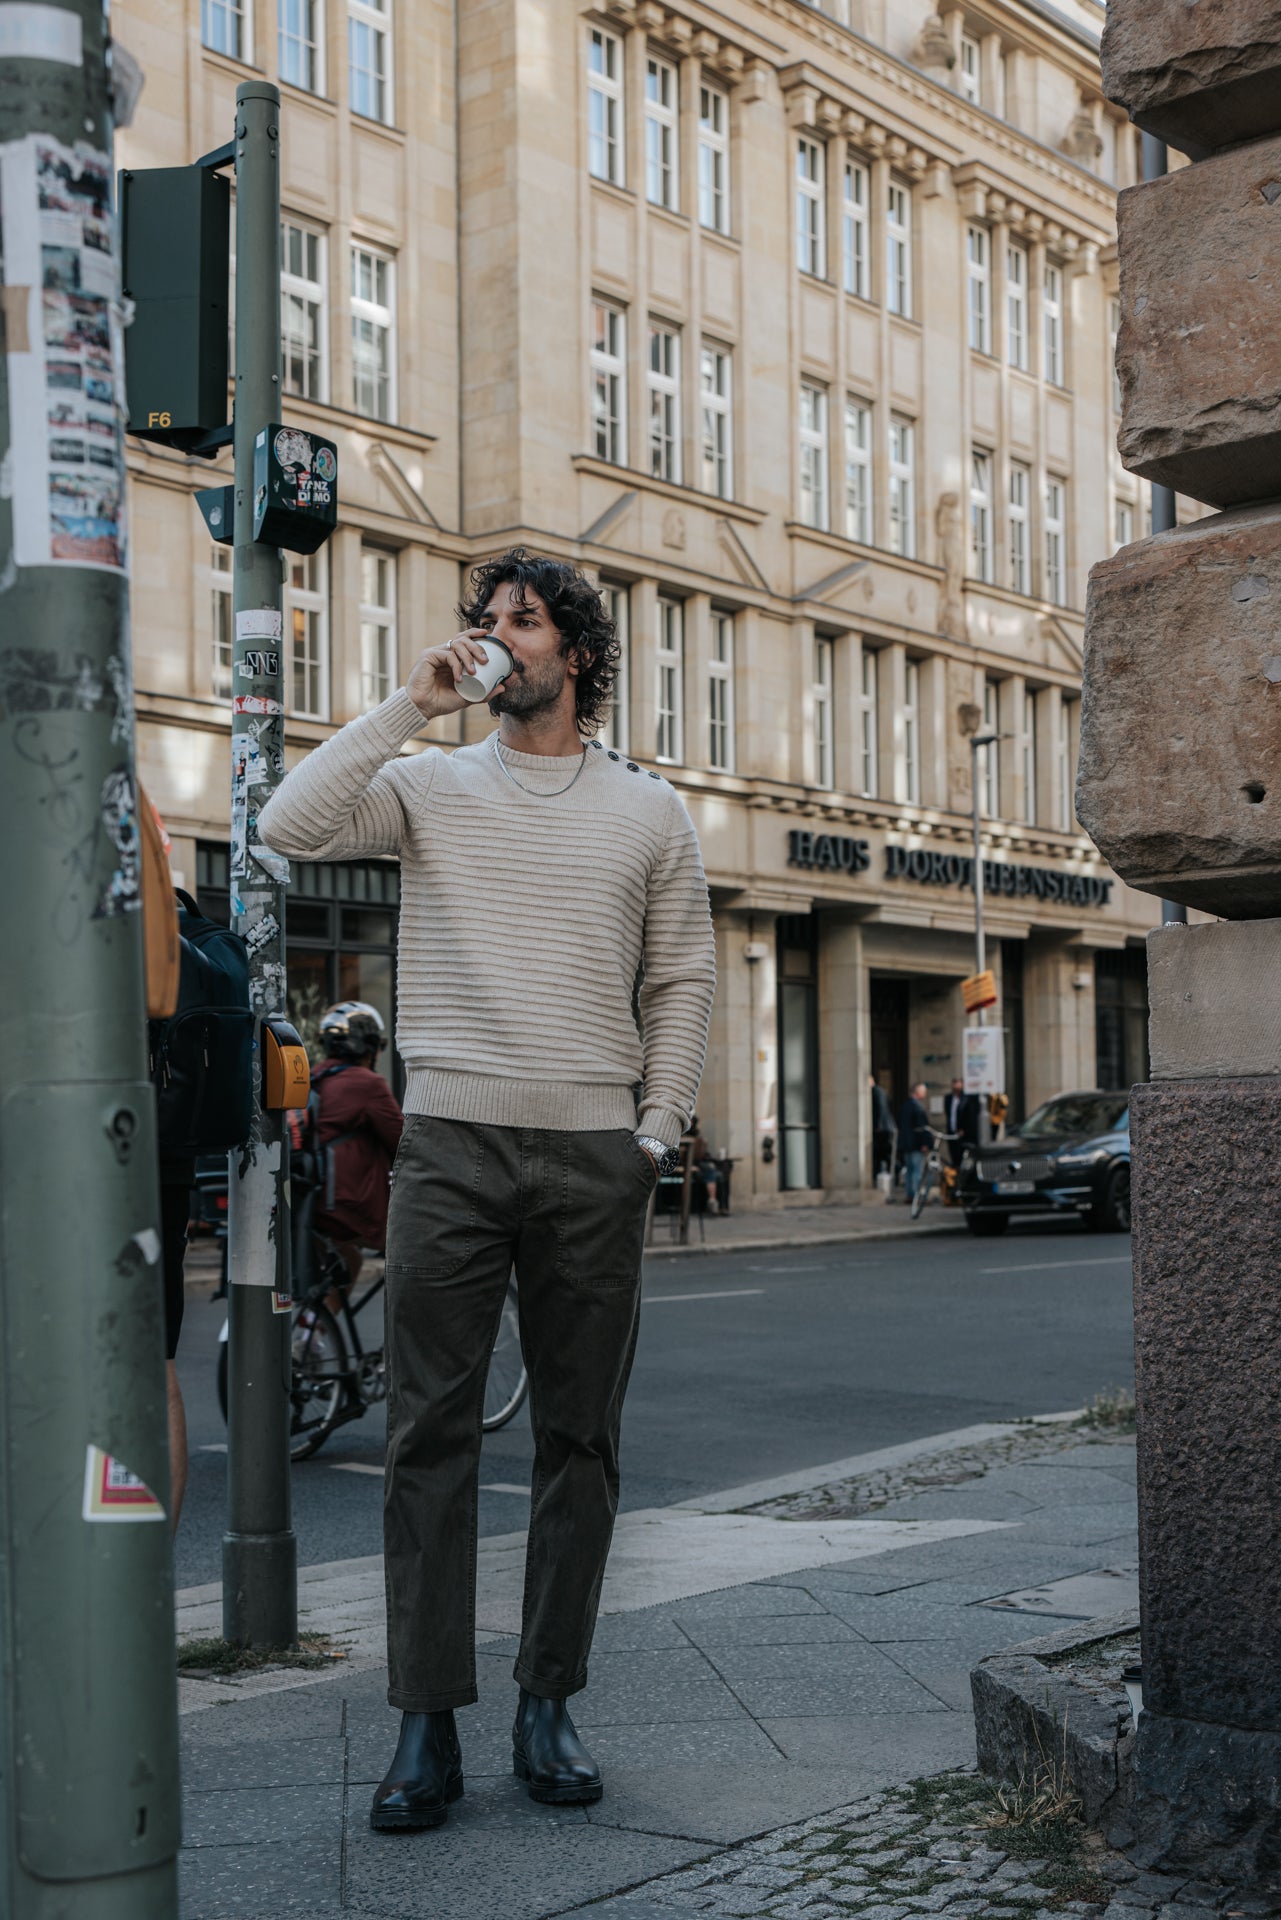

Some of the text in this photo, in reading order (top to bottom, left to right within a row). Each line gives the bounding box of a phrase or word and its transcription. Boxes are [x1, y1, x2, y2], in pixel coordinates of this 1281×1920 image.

[148, 412, 171, 428] F6
[298, 480, 329, 491] TANZ
[788, 830, 1114, 905] HAUS DOROTHEENSTADT
